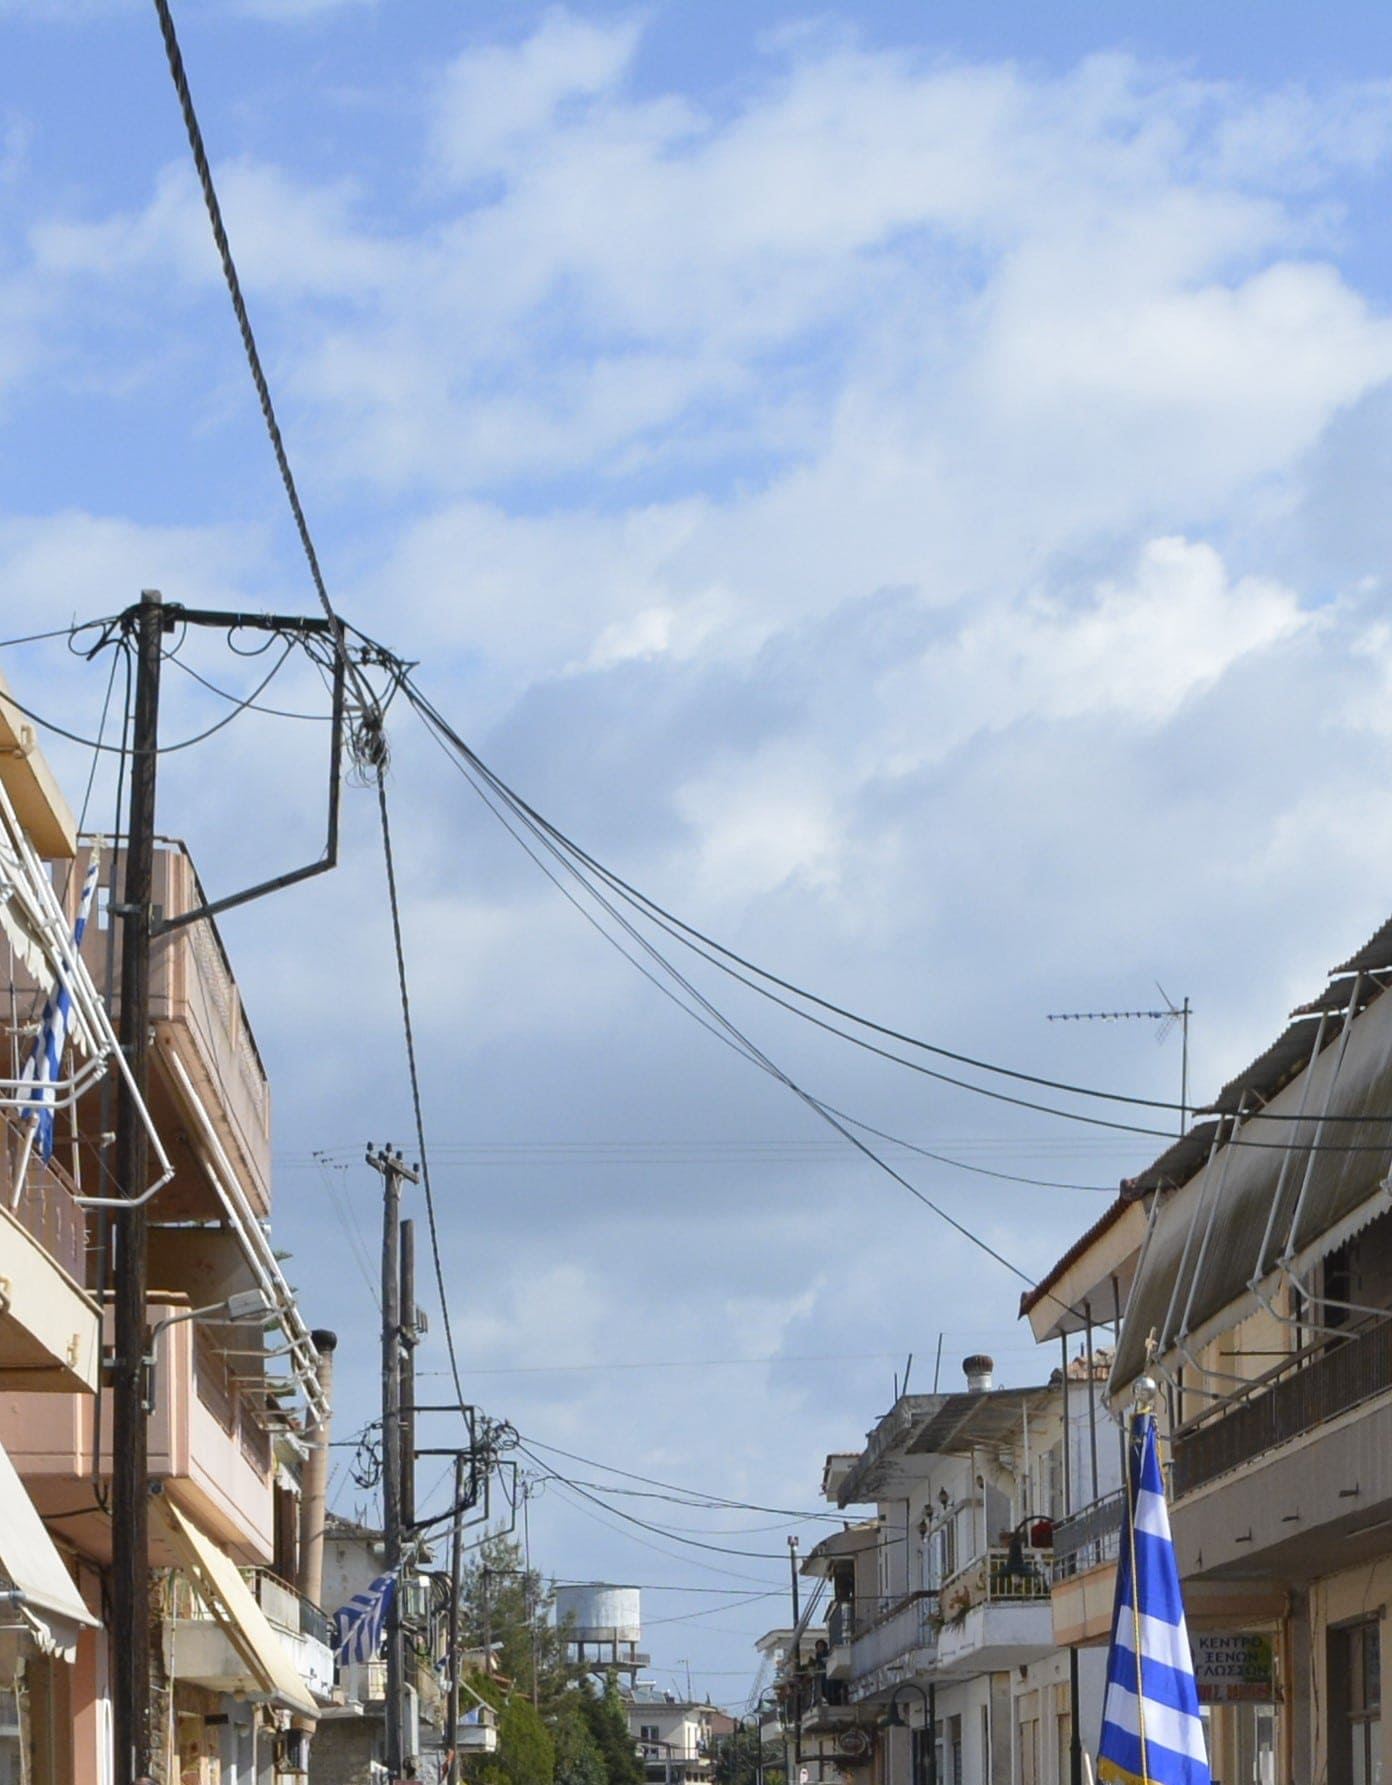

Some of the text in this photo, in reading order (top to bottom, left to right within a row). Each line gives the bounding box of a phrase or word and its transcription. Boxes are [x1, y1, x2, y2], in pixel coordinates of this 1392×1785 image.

[1200, 1637, 1263, 1649] ΚΕΝΤΡΟ
[1204, 1651, 1258, 1663] ΞΕΝΩΝ
[1194, 1665, 1269, 1677] ΓΛΩΣΣΩΝ
